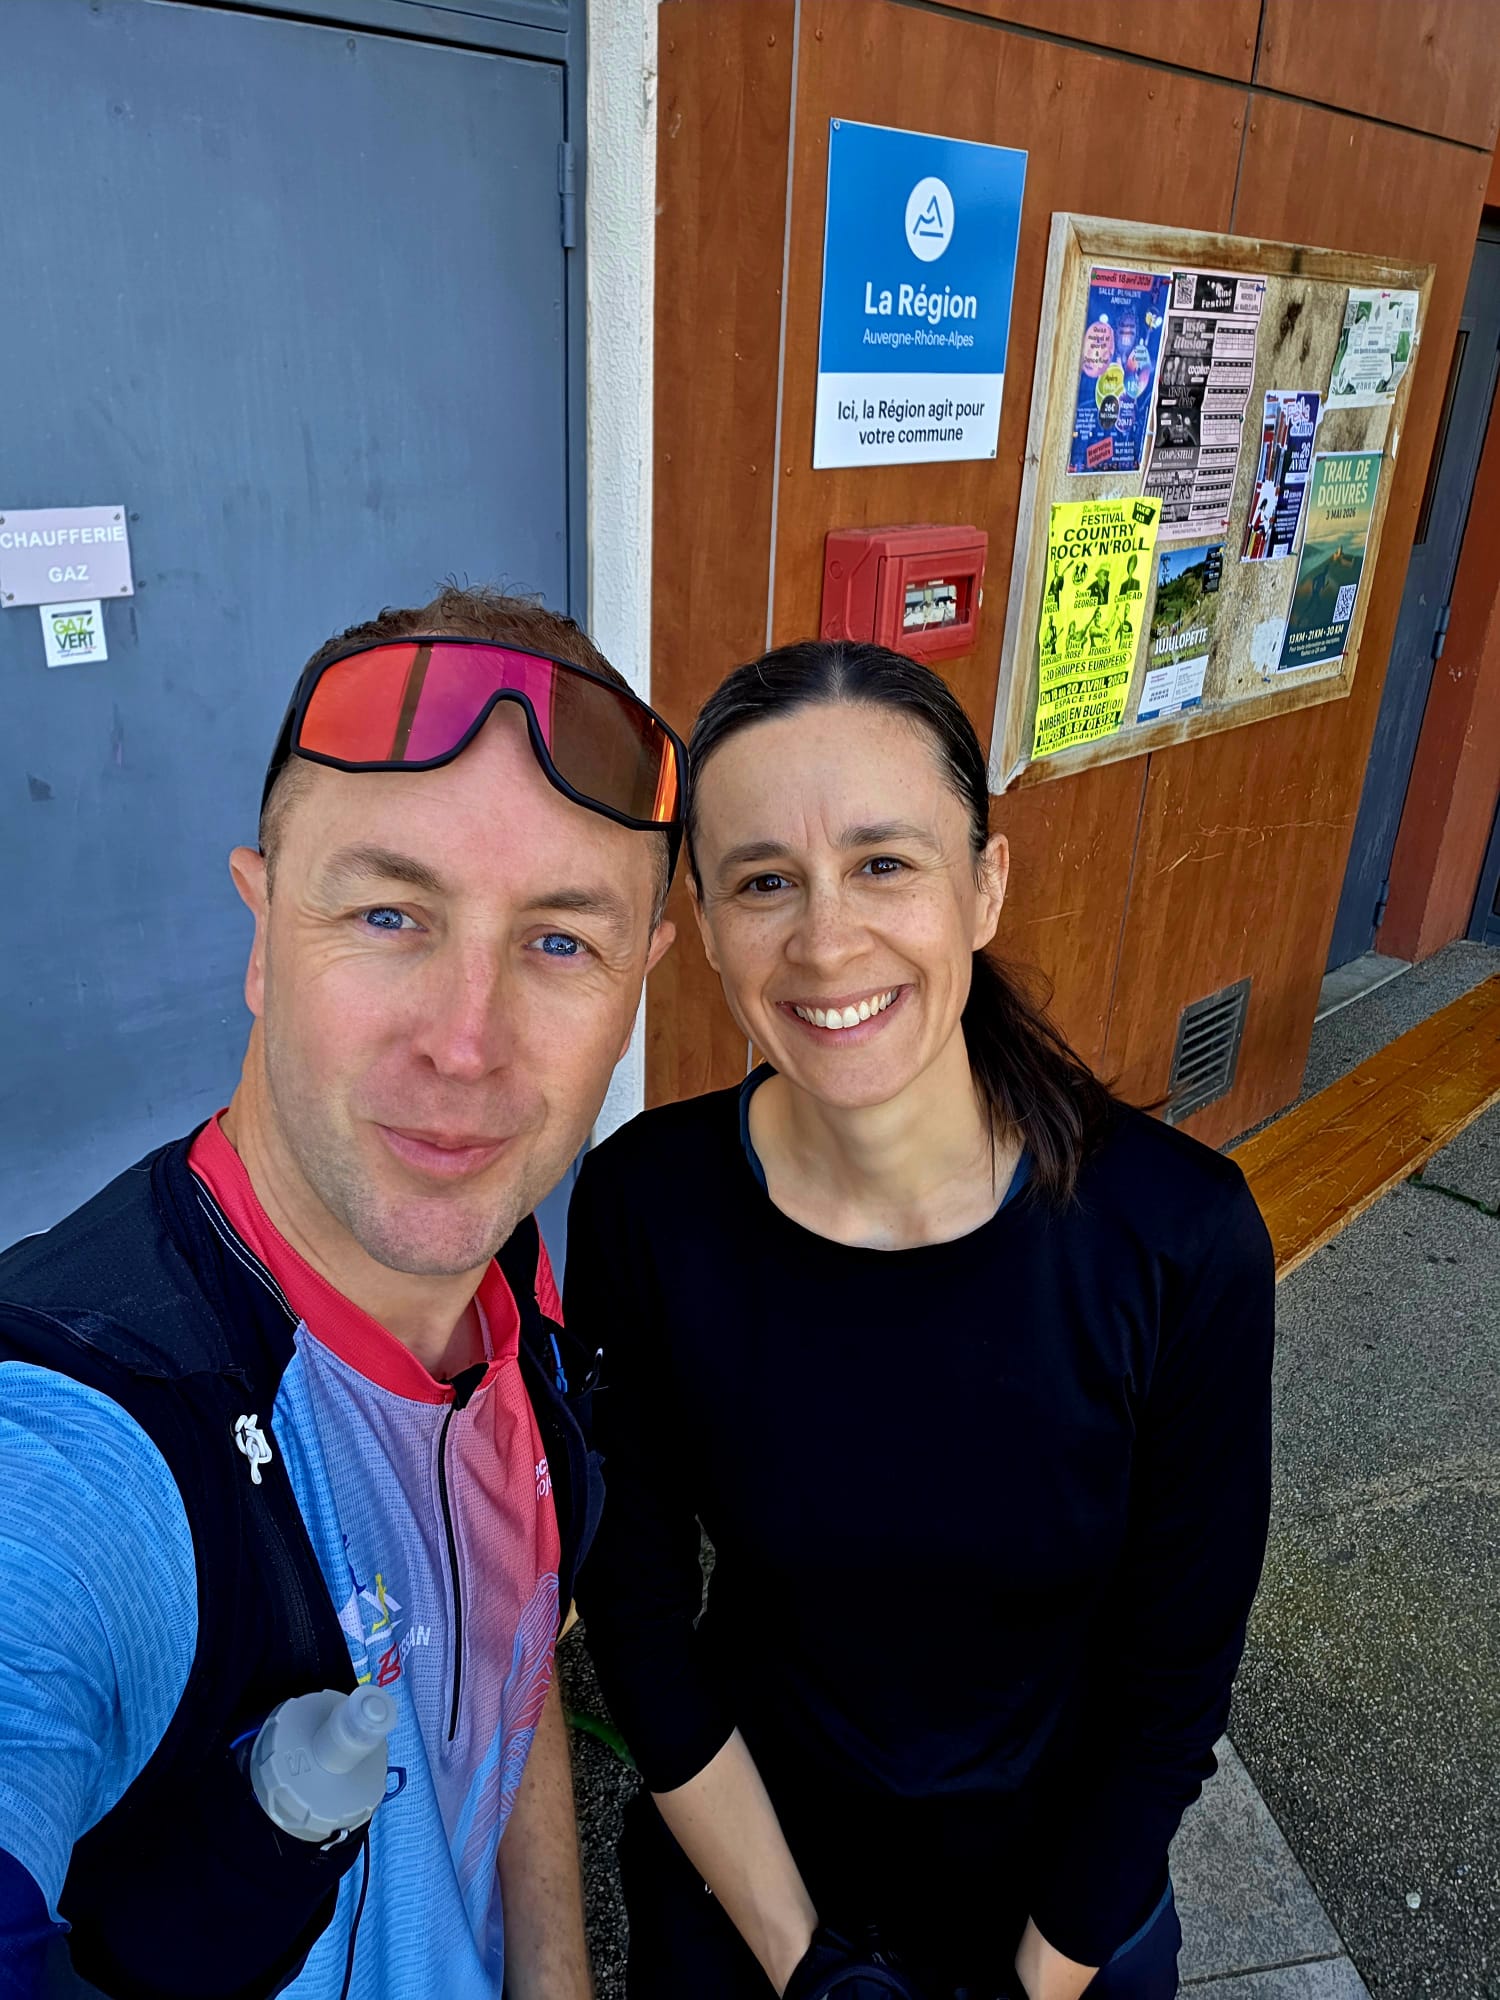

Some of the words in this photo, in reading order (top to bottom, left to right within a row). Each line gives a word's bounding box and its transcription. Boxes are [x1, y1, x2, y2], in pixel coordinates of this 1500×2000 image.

[1091, 272, 1117, 282] amedi
[865, 282, 893, 315] La
[898, 283, 977, 325] Région
[863, 328, 975, 350] Auvergne-Rhône-Alpes
[838, 401, 858, 421] Ici,
[863, 400, 875, 419] la
[878, 400, 925, 422] Région
[928, 399, 953, 421] agit
[955, 402, 985, 420] pour
[859, 428, 895, 445] votre
[898, 427, 963, 443] commune
[1323, 460, 1352, 483] TRAIL
[1354, 459, 1371, 481] DE
[1317, 482, 1368, 507] DOUVRES
[1081, 511, 1125, 526] FESTIVAL
[1331, 508, 1342, 519] MAI
[1343, 506, 1356, 518] 2026
[0, 526, 125, 549] CHAUFFERIE
[1064, 523, 1136, 542] COUNTRY
[1051, 537, 1150, 561] ROCK'N'ROLL
[48, 565, 90, 583] GAZ
[53, 617, 86, 635] GAZ
[55, 631, 95, 649] VERT
